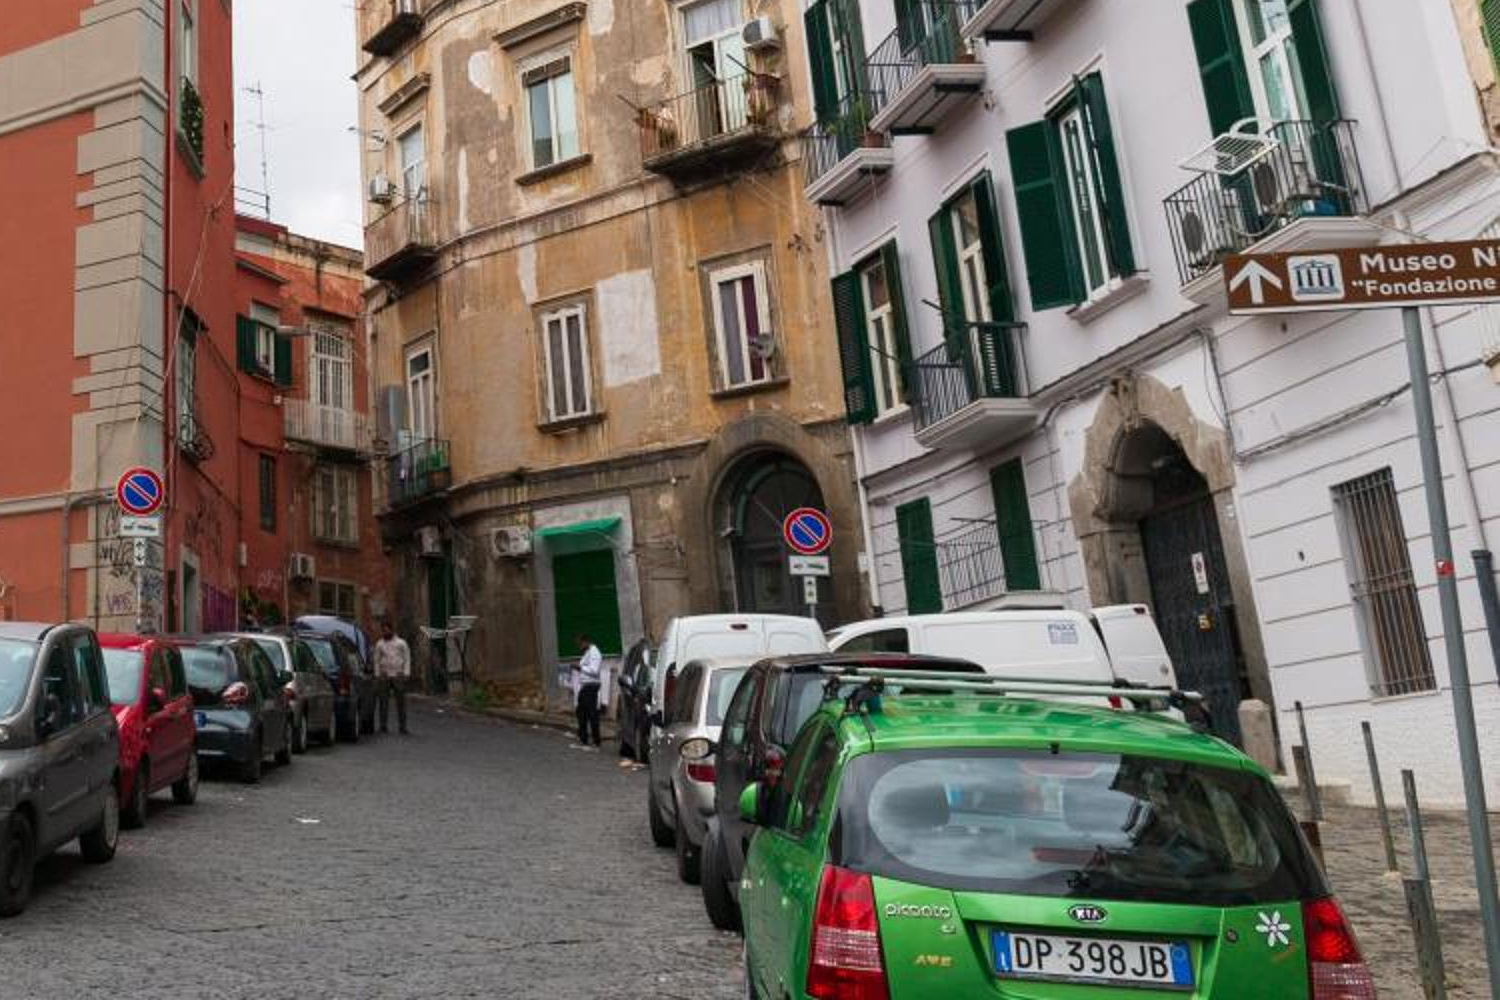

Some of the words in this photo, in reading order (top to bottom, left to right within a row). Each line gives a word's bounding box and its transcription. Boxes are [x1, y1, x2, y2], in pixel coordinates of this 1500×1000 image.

[1359, 253, 1457, 274] Museo
[1075, 907, 1102, 921] KIA
[1014, 937, 1052, 970] DP
